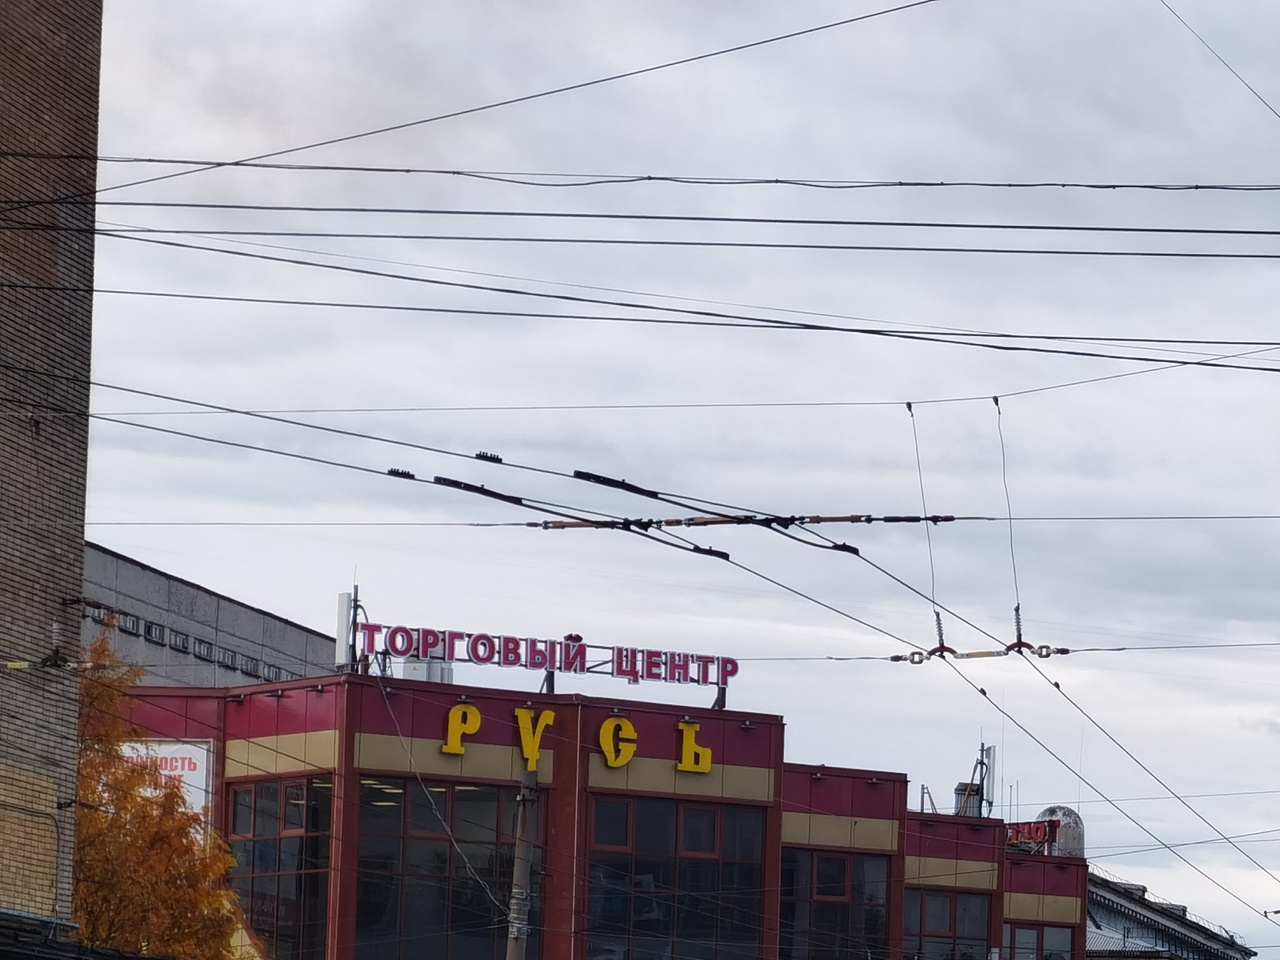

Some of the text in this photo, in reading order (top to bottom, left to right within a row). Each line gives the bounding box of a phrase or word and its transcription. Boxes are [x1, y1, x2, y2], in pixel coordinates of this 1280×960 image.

[358, 621, 739, 688] ТОРГОВЫЙ ЦЕНТР
[441, 704, 712, 774] РУСЬ
